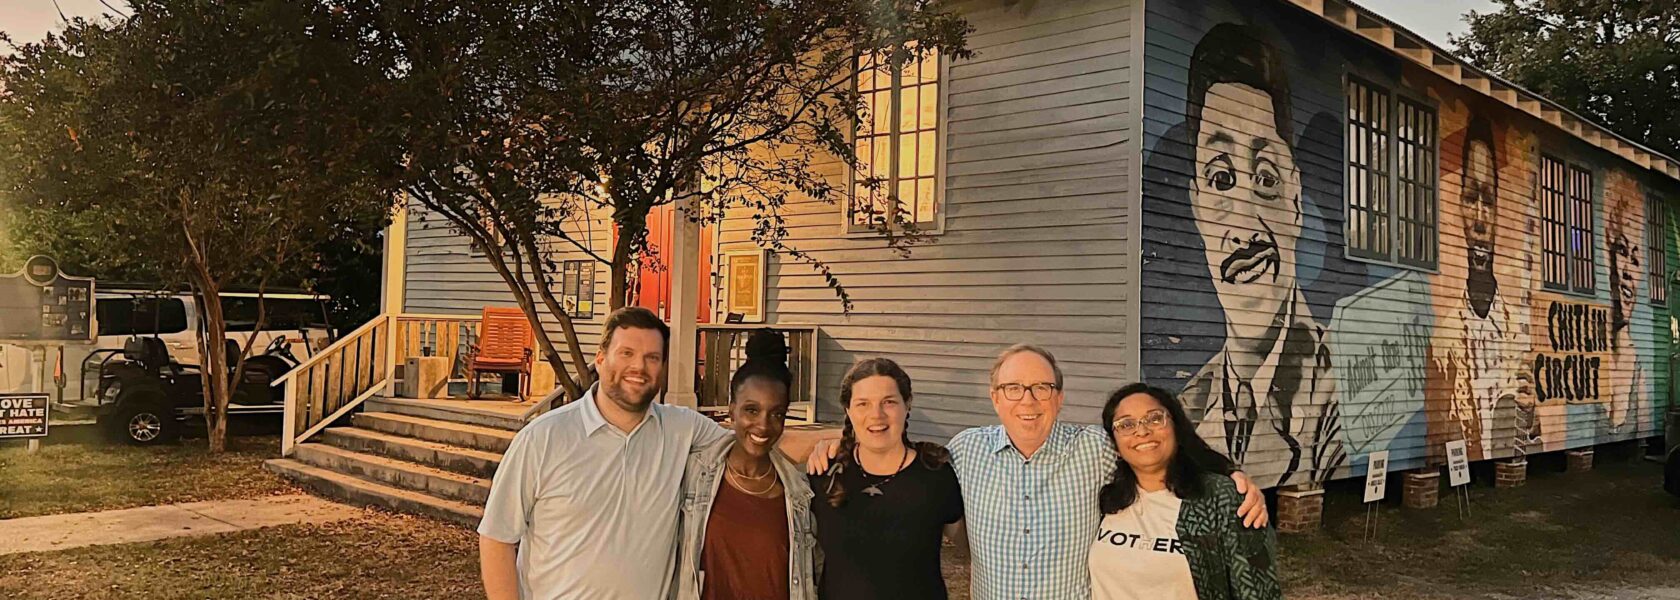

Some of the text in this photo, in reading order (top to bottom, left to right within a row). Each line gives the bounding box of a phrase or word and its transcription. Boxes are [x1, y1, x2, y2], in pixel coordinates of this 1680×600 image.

[1548, 300, 1607, 352] CHITLIN
[1347, 339, 1401, 402] Admit One
[1534, 353, 1600, 402] CIRCUIT
[0, 399, 32, 408] OVE
[10, 408, 44, 417] HATE
[0, 425, 32, 434] REAT
